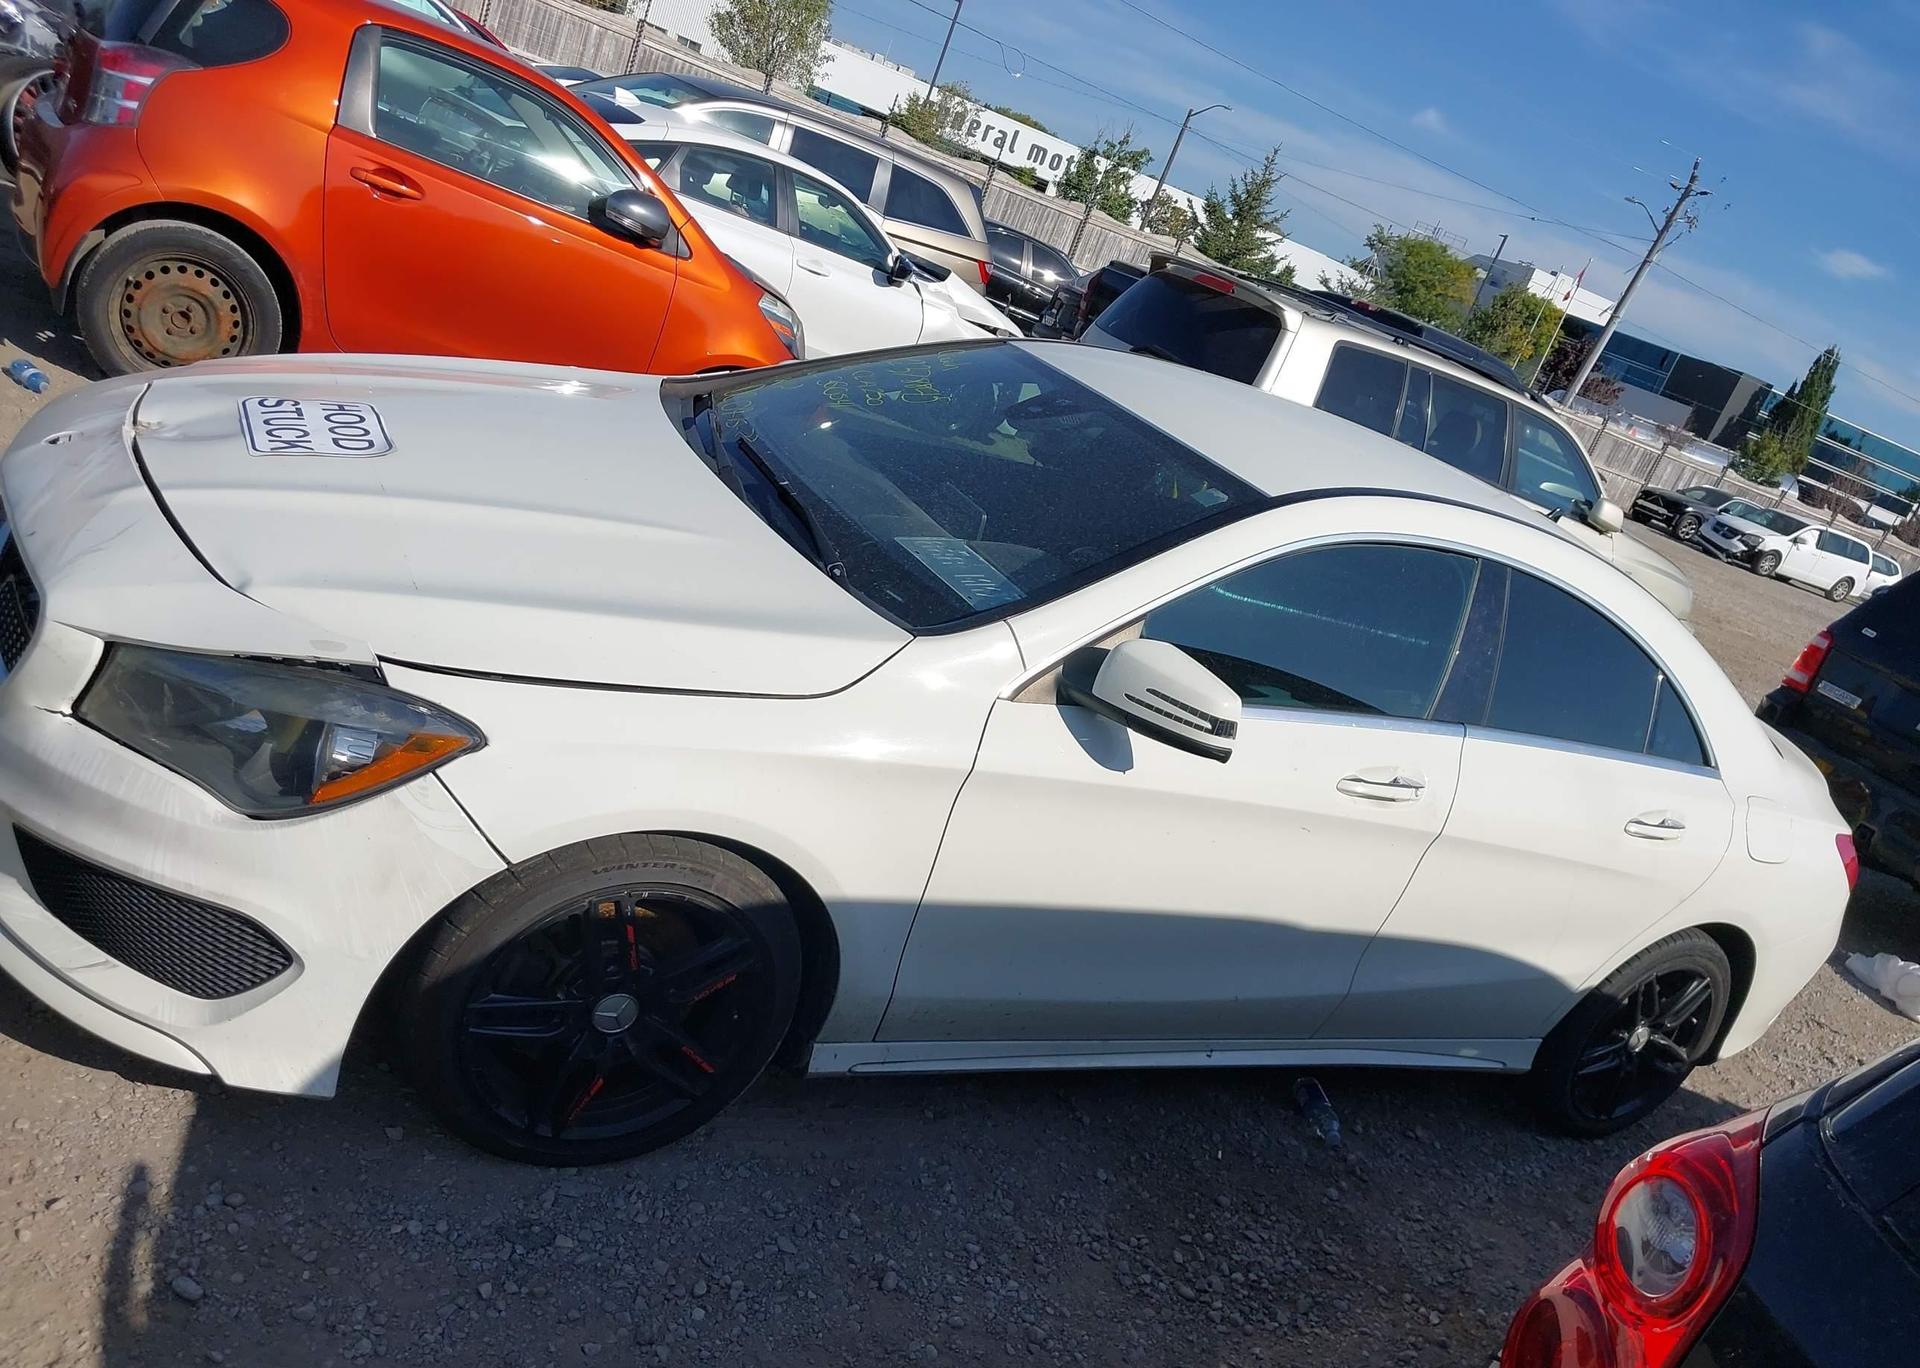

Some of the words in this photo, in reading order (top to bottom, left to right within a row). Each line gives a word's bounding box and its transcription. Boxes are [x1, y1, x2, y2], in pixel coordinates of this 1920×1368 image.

[1027, 143, 1077, 172] mot
[258, 399, 314, 451] STUCK
[320, 403, 375, 450] HOOD
